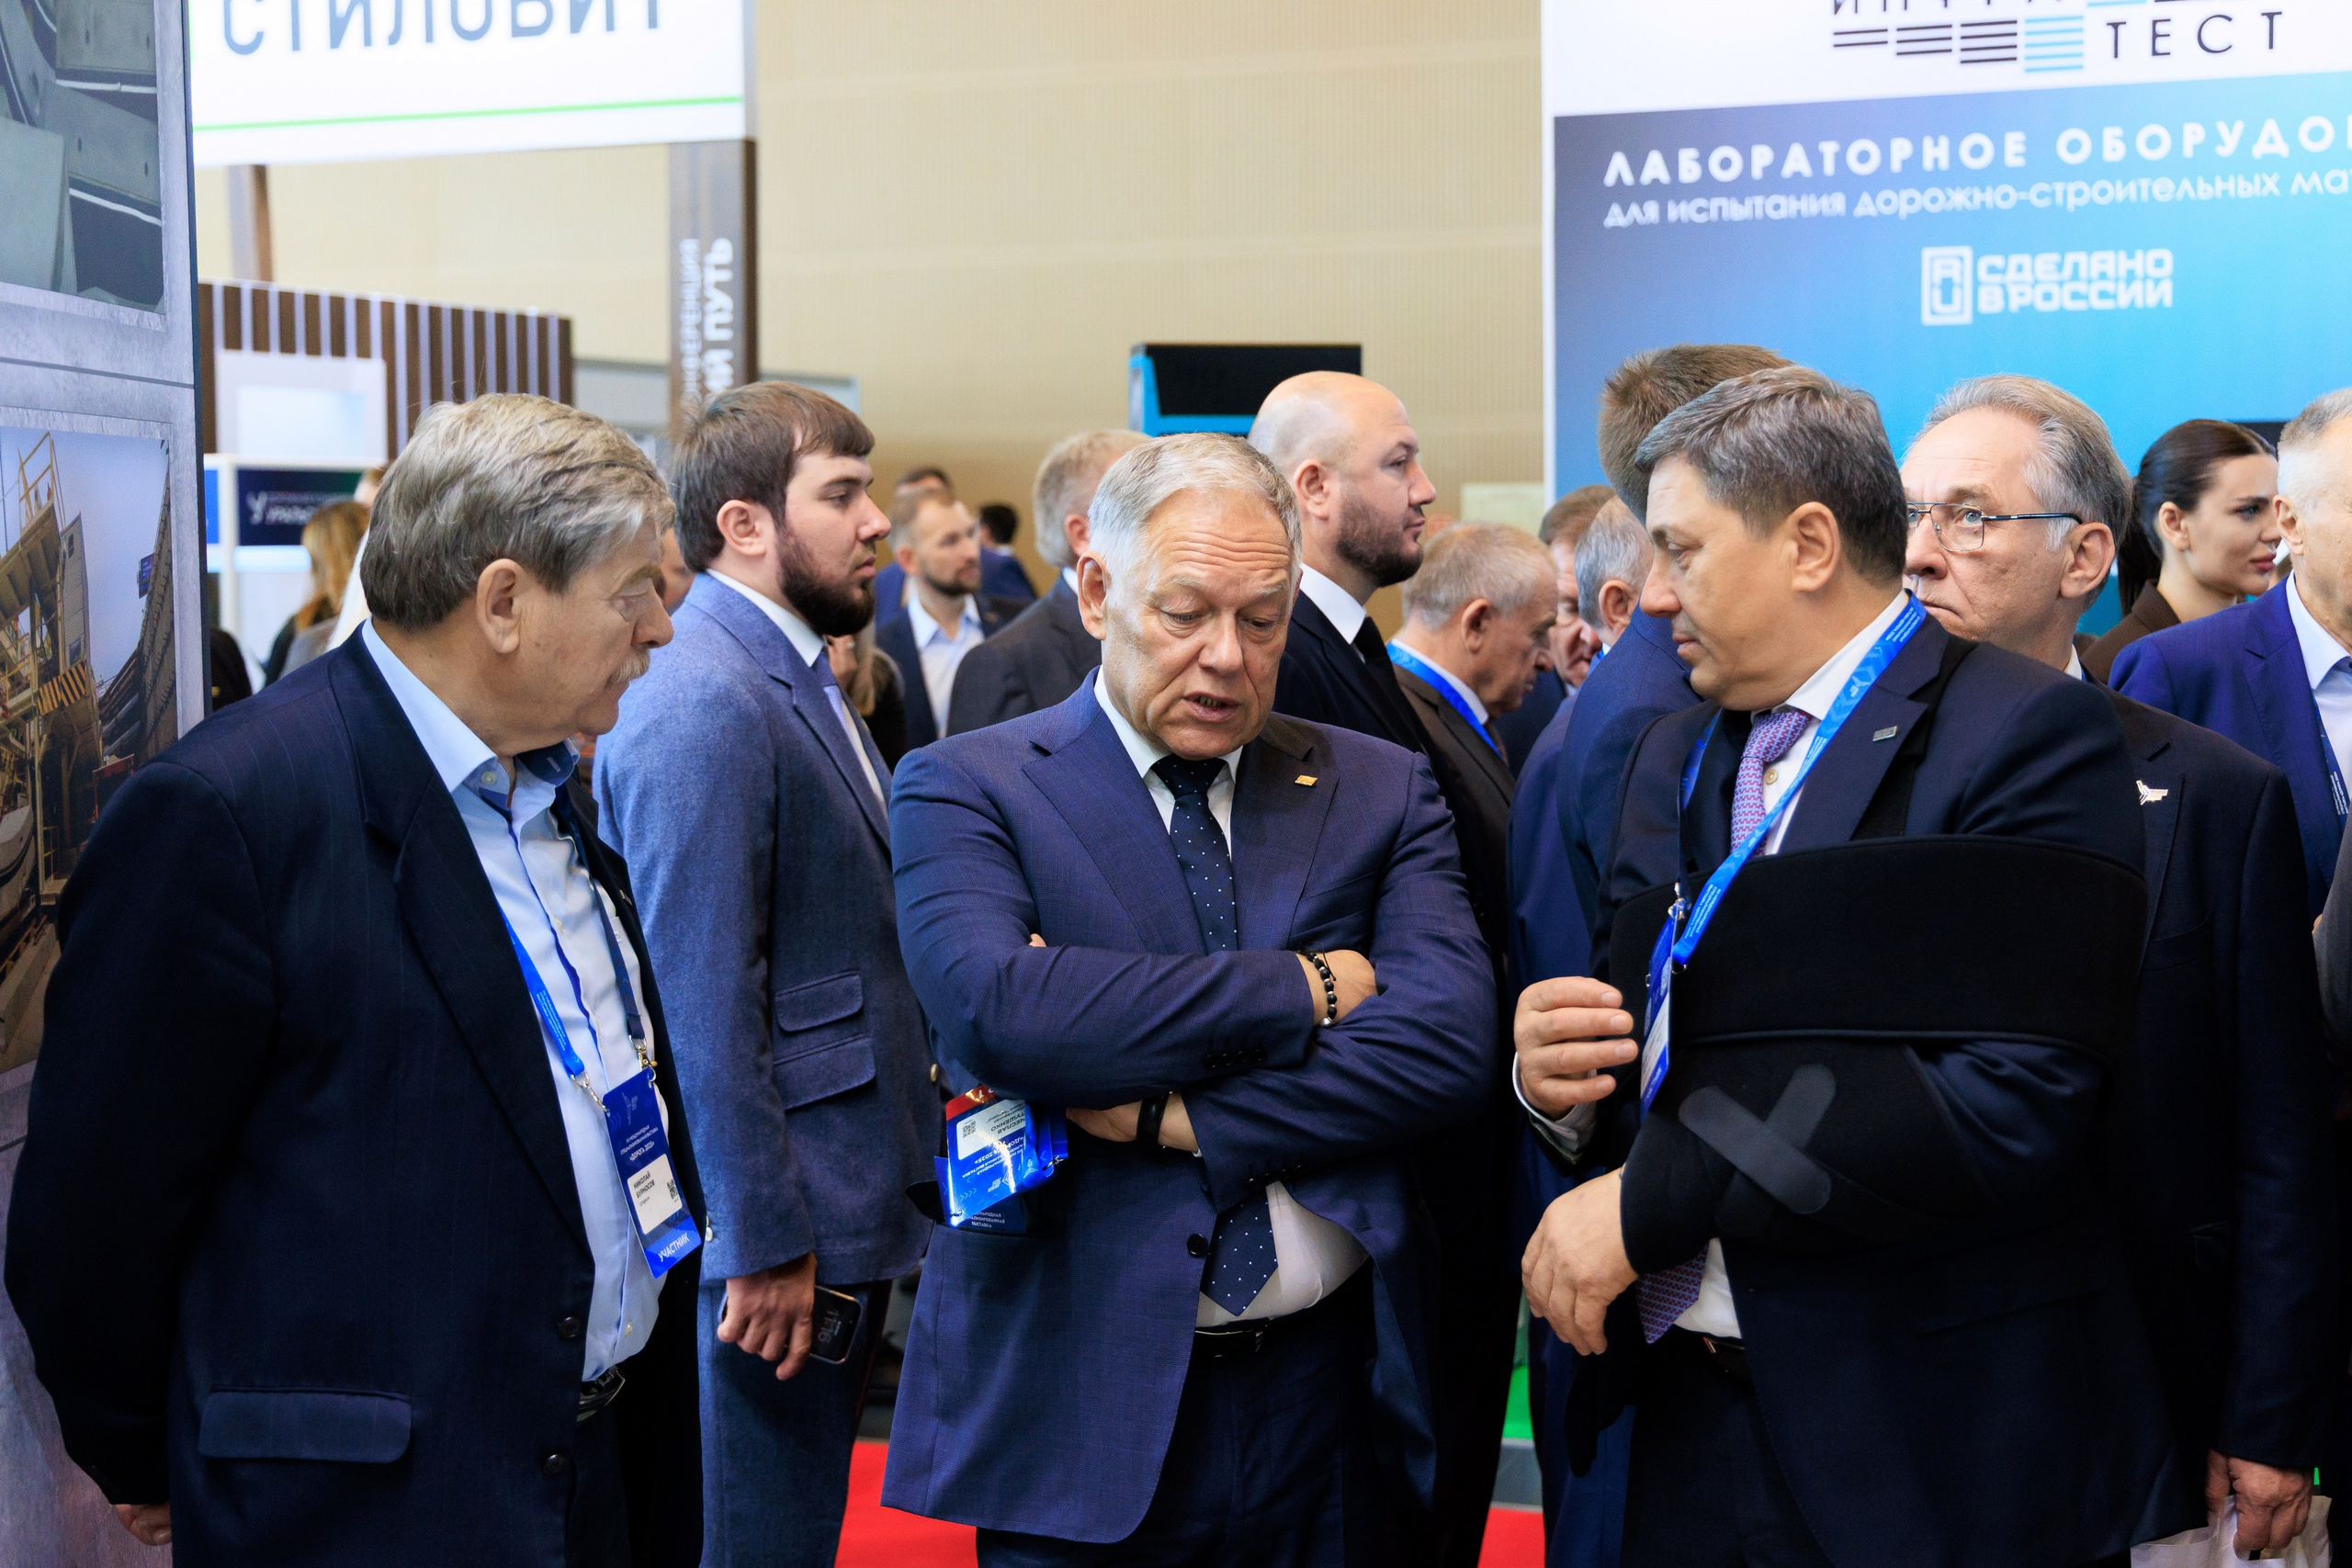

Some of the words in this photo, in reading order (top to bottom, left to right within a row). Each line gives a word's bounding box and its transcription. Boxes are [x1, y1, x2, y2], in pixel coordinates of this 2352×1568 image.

[2106, 11, 2283, 59] ТЕСТ
[1602, 130, 2027, 186] ЛАБОРАТОРНОЕ
[2055, 114, 2352, 165] ОБОРУДО
[1667, 191, 1846, 223] испытания
[2290, 167, 2352, 195] ма
[1977, 248, 2174, 285] СДЕЛАНО
[703, 237, 734, 341] ПУТЬ
[990, 1111, 1025, 1132] ТУШЕНКО
[997, 1118, 1025, 1134] ЧЕСЛАВ
[658, 1232, 690, 1263] УЧАСТНИК
